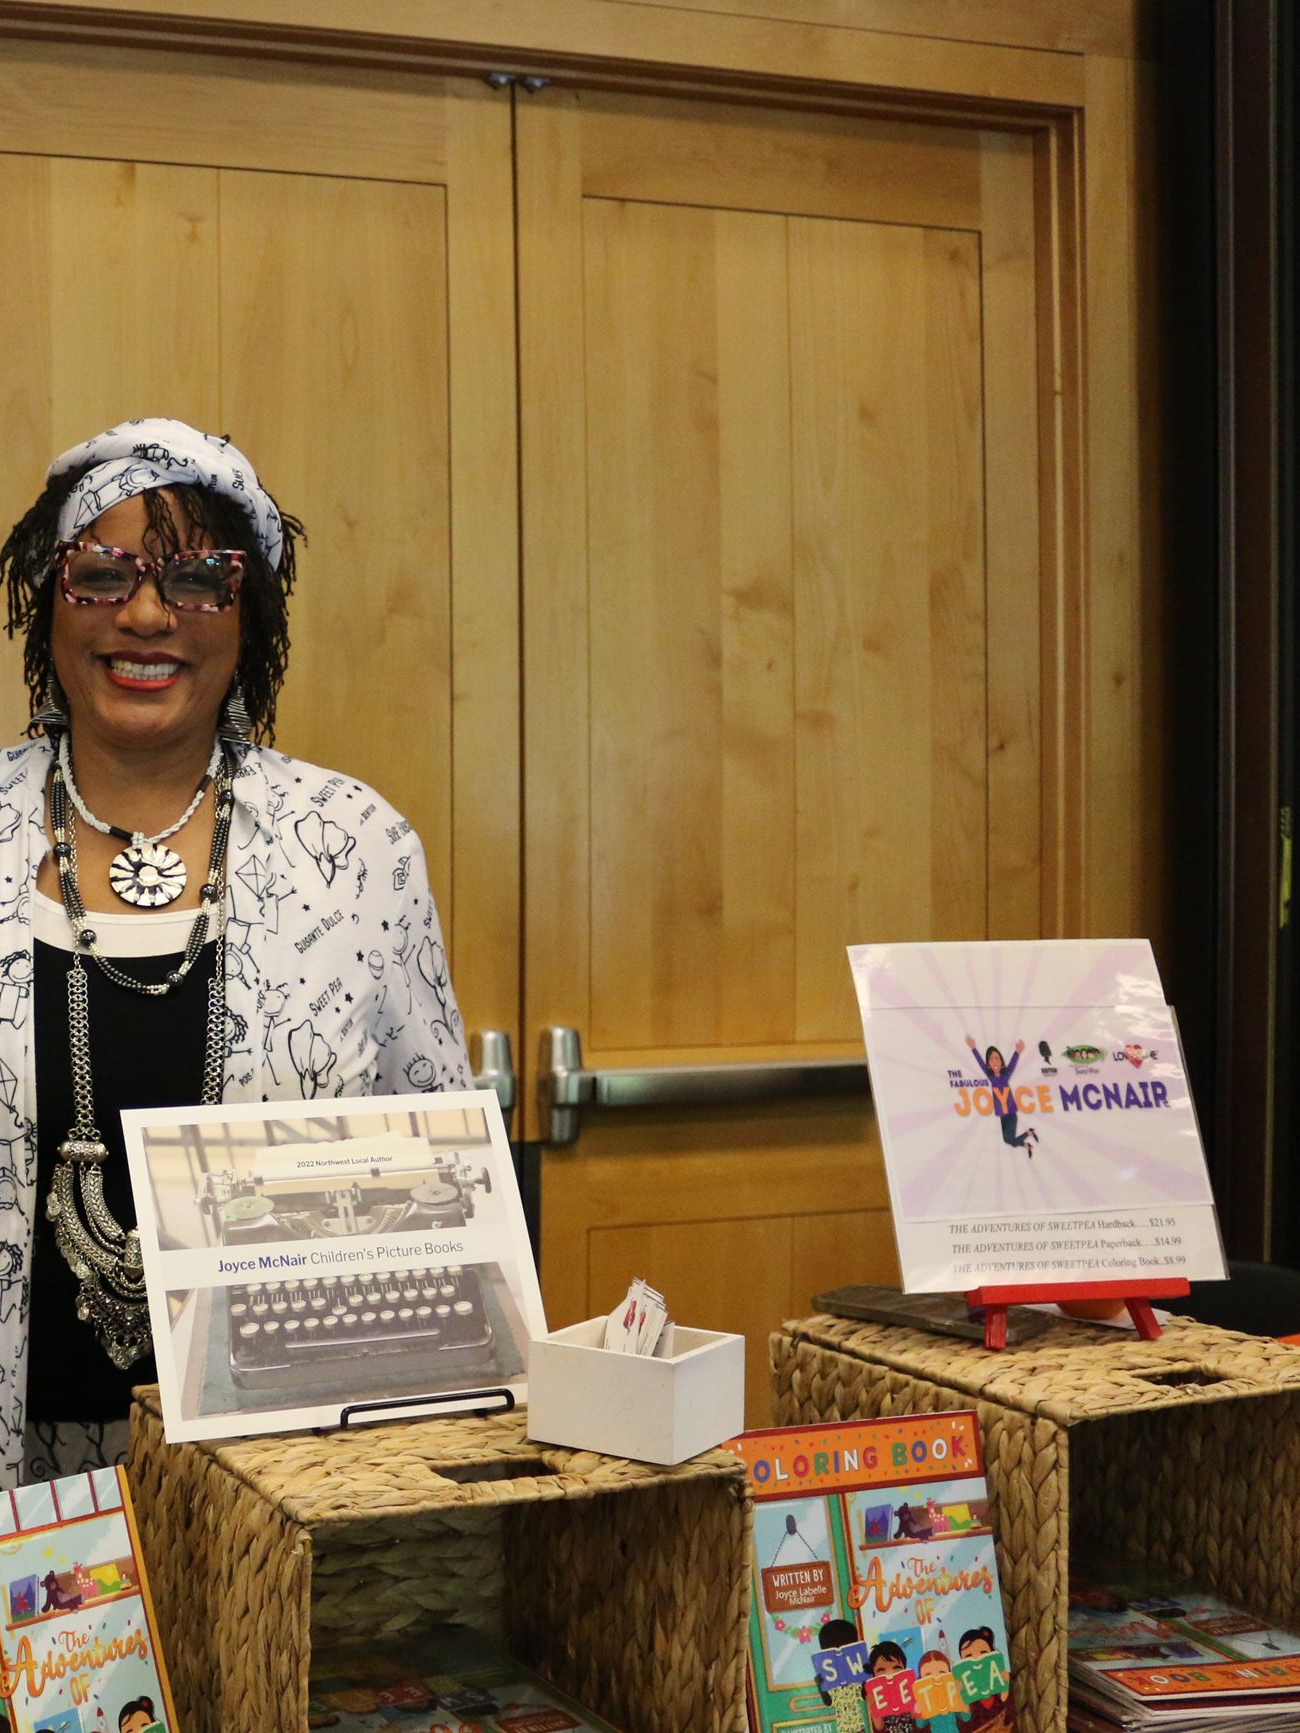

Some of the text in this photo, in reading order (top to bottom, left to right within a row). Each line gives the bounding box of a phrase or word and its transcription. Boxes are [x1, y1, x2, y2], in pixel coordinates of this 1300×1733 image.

[294, 909, 345, 954] GUISANTE DULCE
[308, 977, 344, 1017] SWEET PEA
[947, 1069, 963, 1079] THE
[949, 1078, 990, 1089] FABULOUS
[954, 1081, 1168, 1117] JOYCE MCNAIR
[296, 1154, 393, 1168] 2022 Northwest Local Author
[949, 1224, 969, 1235] THE
[970, 1222, 1032, 1234] ADVENTURES
[1032, 1221, 1045, 1232] OF
[1047, 1220, 1096, 1231] SWEETPEA
[218, 1258, 257, 1274] Joyce
[258, 1254, 308, 1270] McNair
[376, 1243, 423, 1259] Picture
[424, 1240, 464, 1256] Books
[952, 1243, 972, 1254] THE
[973, 1241, 1035, 1254] ADVENTURES
[1035, 1241, 1048, 1251] OF
[1050, 1239, 1099, 1251] SWEETPEA
[974, 1260, 1036, 1273] ADVENTURES
[1036, 1259, 1050, 1271] OF
[1051, 1259, 1100, 1270] SWEETPEA
[1101, 1258, 1138, 1269] Coloring
[891, 1434, 966, 1467] BOOK
[906, 1557, 937, 1577] The
[772, 1569, 825, 1588] WRITTEN BY
[847, 1556, 993, 1613] Adventures
[775, 1584, 828, 1602] Joyce Labelle
[915, 1599, 936, 1626] OF
[58, 1631, 90, 1653] The
[69, 1673, 92, 1707] OF
